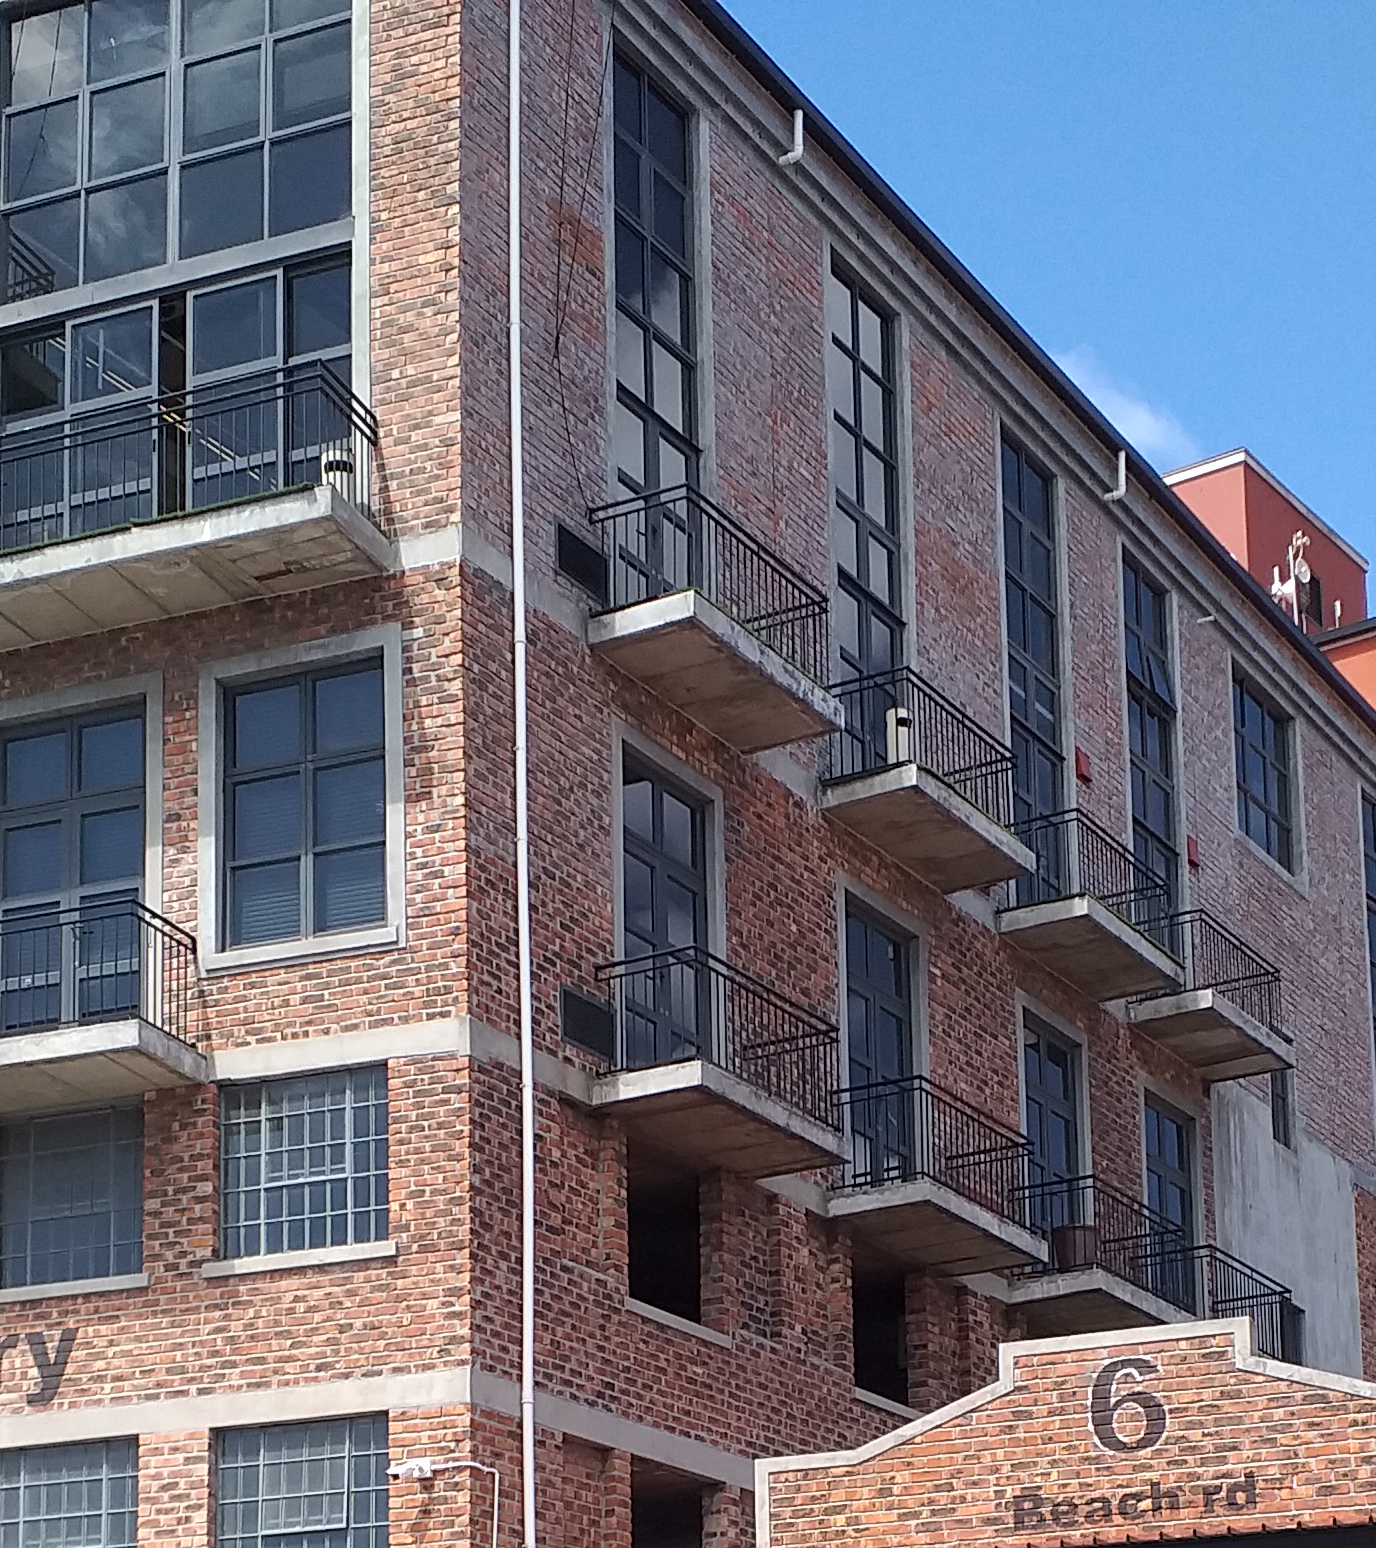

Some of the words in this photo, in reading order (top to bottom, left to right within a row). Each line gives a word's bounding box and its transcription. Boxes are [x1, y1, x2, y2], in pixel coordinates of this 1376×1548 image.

[1087, 1354, 1170, 1456] 6
[1012, 1479, 1180, 1532] Beach
[1200, 1469, 1258, 1514] rd
